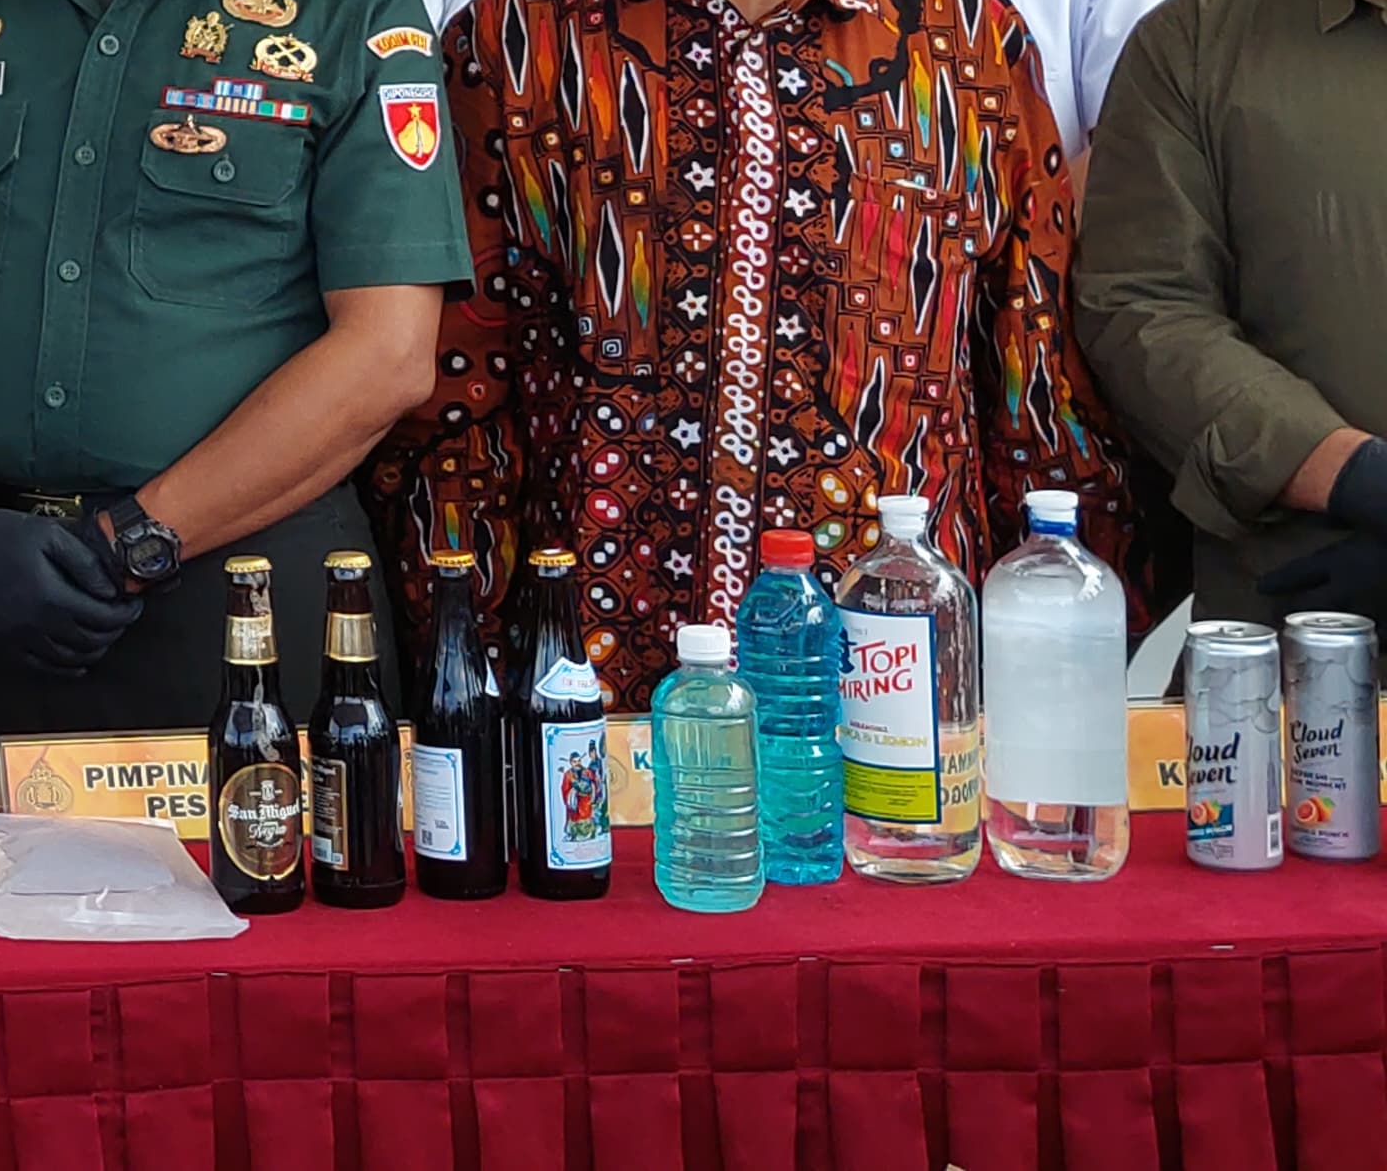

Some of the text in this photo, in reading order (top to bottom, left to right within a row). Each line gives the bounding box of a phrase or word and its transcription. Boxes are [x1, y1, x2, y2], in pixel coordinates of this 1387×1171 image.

[853, 640, 918, 674] TOPI
[1290, 719, 1344, 744] Cloud
[1294, 742, 1341, 765] Seven
[228, 796, 301, 822] San Miguel
